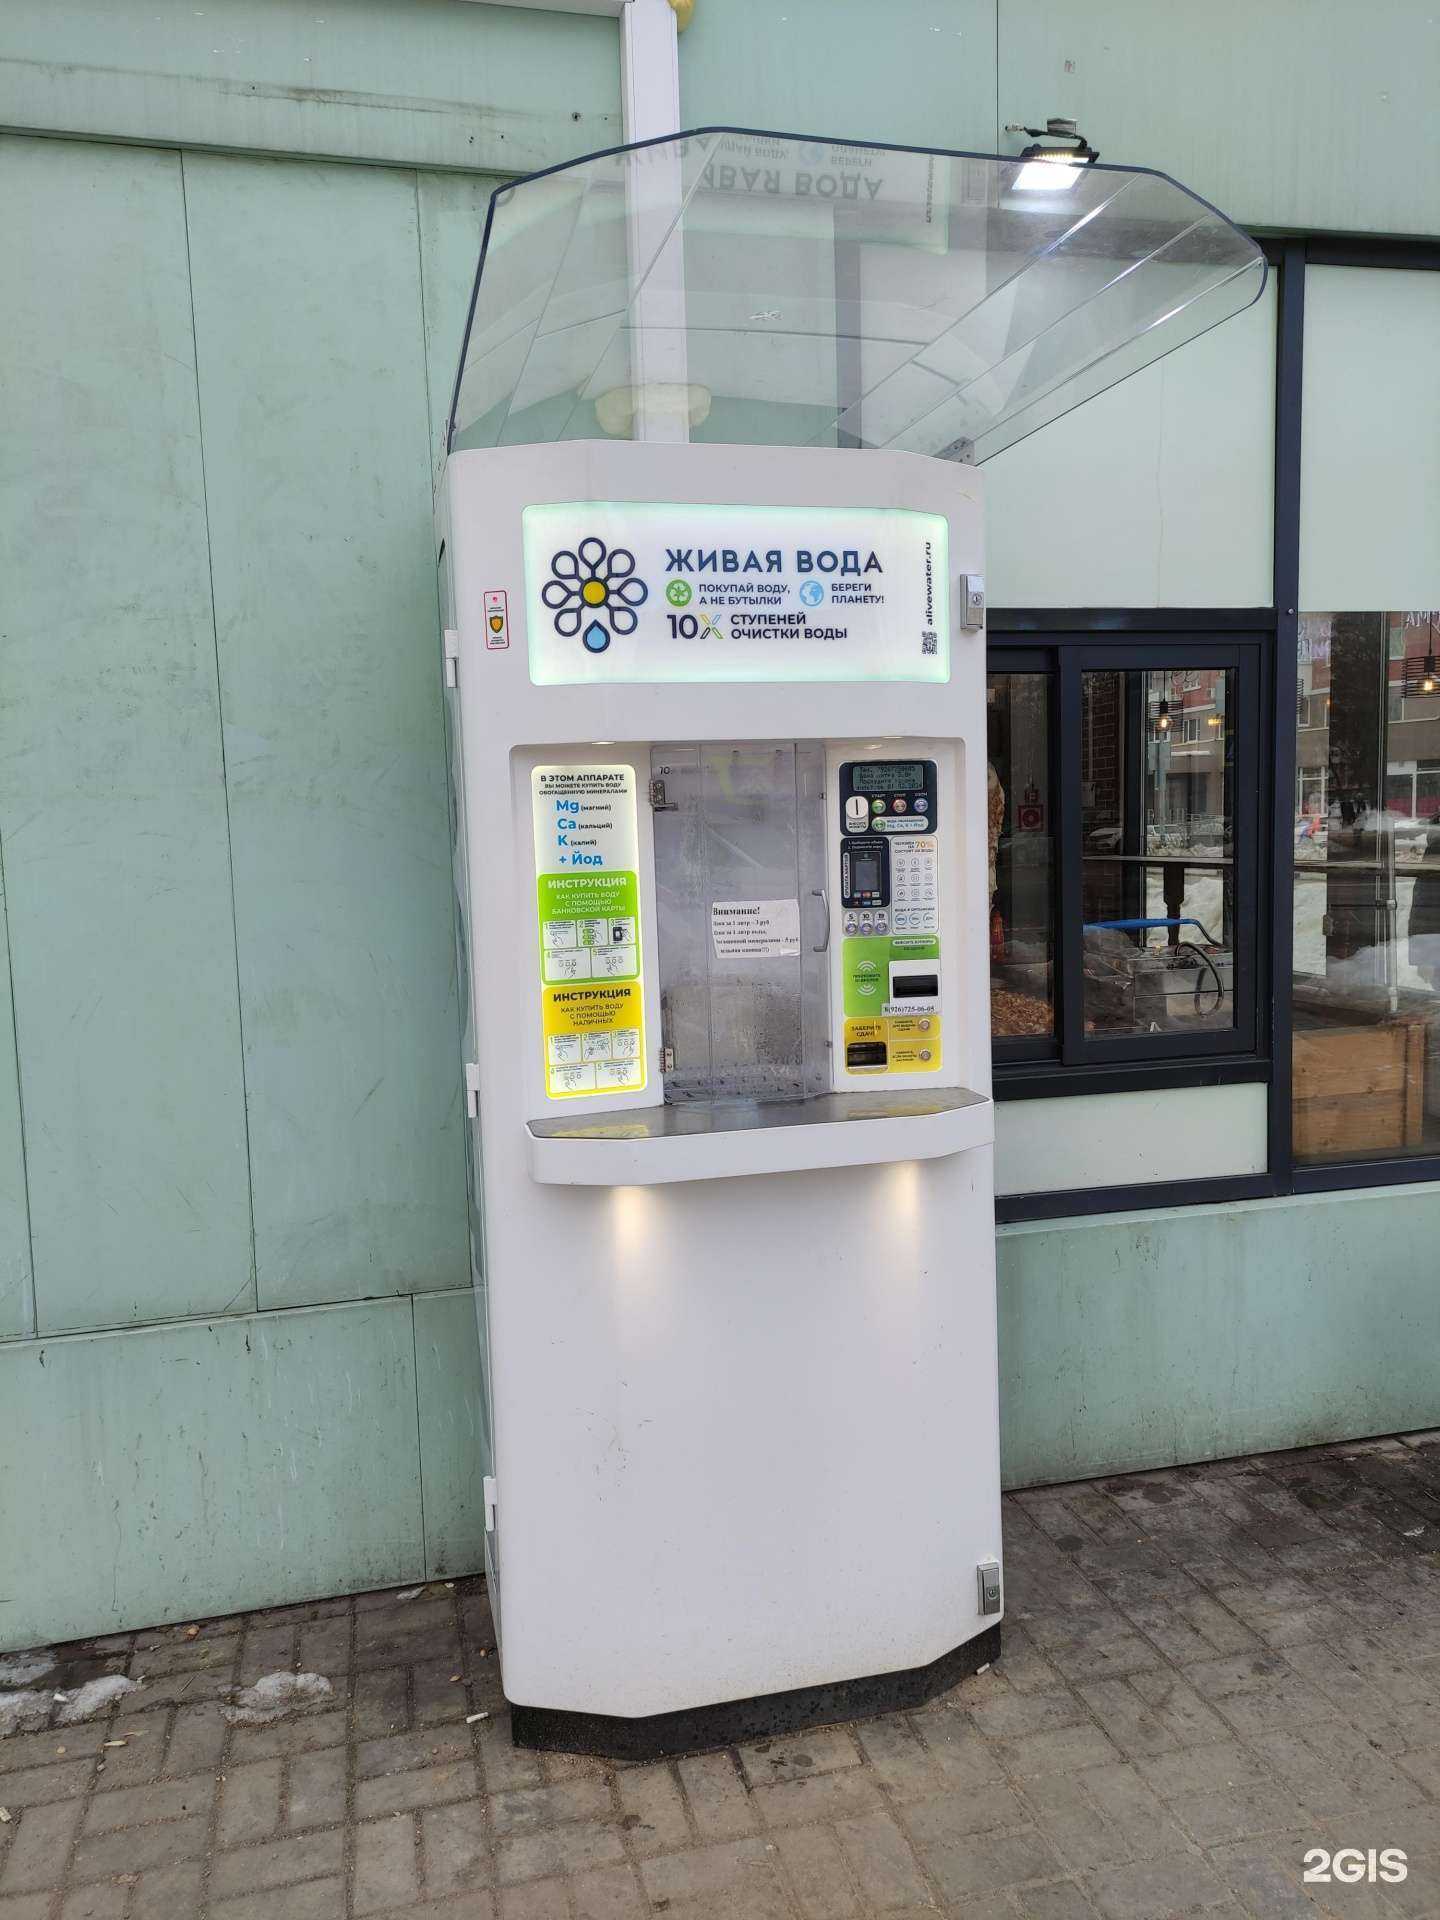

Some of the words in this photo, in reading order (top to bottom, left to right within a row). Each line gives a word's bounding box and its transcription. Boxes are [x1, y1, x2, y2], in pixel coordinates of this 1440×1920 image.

[665, 549, 782, 573] ЖИВАЯ
[797, 550, 883, 576] ВОДА
[699, 583, 754, 593] ПОКУПАЙ
[757, 584, 790, 594] ВОДУ,
[831, 583, 872, 592] БЕРЕГИ
[925, 541, 933, 626] alivewater.ru
[699, 596, 707, 605] А
[710, 596, 726, 605] НЕ
[728, 596, 782, 605] БУТЫЛКИ
[831, 595, 885, 604] ПЛАНЕТУ!
[730, 612, 806, 625] СТУПЕНЕЙ
[731, 628, 799, 640] ОЧИСТКИ
[804, 628, 848, 641] ВОДЫ
[549, 774, 575, 782] ЭТОМ
[577, 773, 625, 782] АППАРАТЕ
[556, 799, 579, 813] Mg
[557, 818, 577, 830] Ca
[578, 822, 613, 830] (кальций)
[570, 839, 597, 847] (калий)
[571, 850, 603, 866] Йод
[547, 877, 627, 889] ИНСТРУКЦИЯ
[551, 907, 601, 915] БАНКОВСКОЙ
[713, 906, 760, 916] Внимание!
[553, 988, 631, 1002] ИНСТРУКЦИЯ
[576, 1011, 616, 1019] ПОМОЩЬЮ
[573, 1018, 614, 1026] НАЛИЧНЫХ
